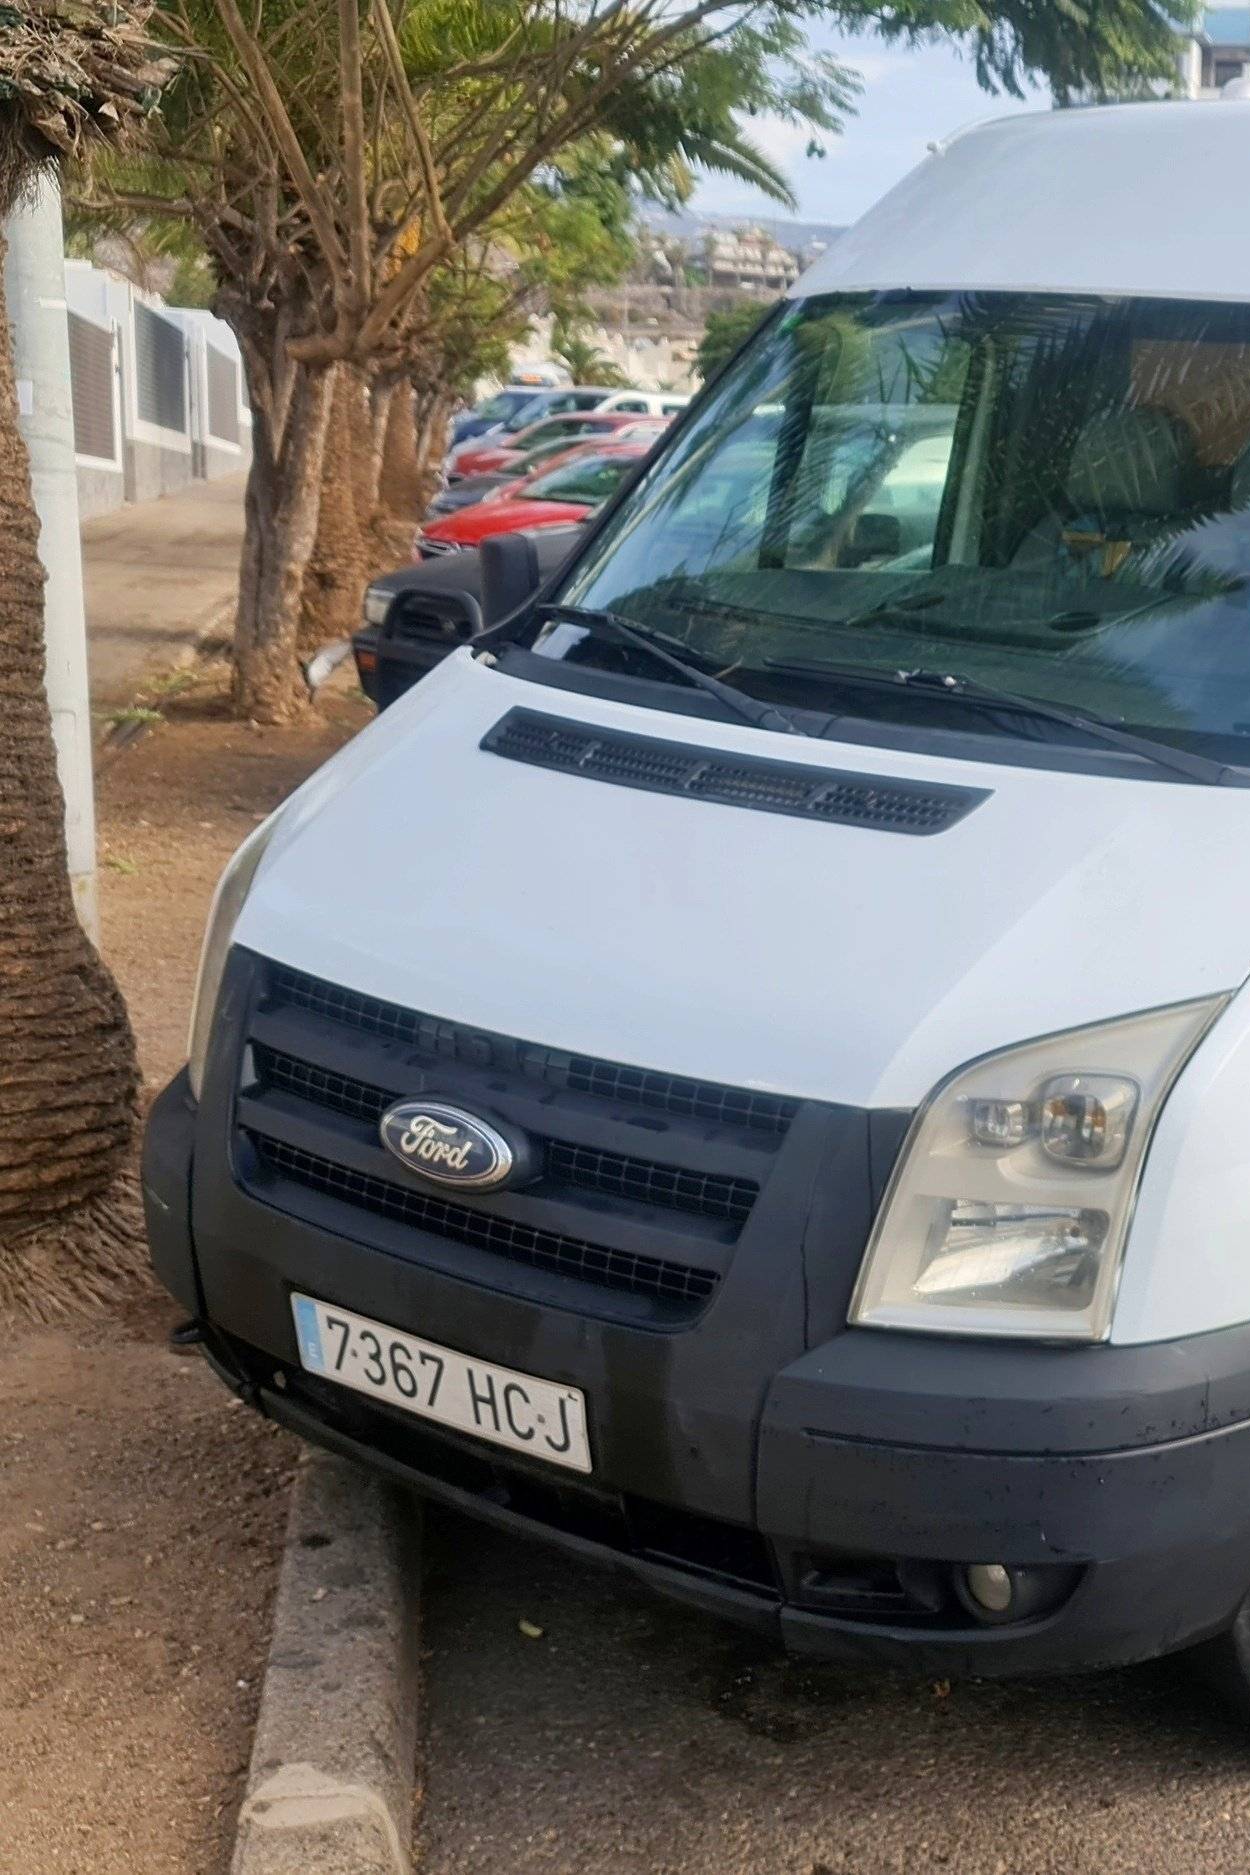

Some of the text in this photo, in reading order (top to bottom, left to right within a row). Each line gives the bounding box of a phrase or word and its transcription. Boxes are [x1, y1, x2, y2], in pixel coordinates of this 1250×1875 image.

[400, 1114, 473, 1170] Ford
[326, 1315, 445, 1408] 7367
[467, 1367, 571, 1453] HCJ
